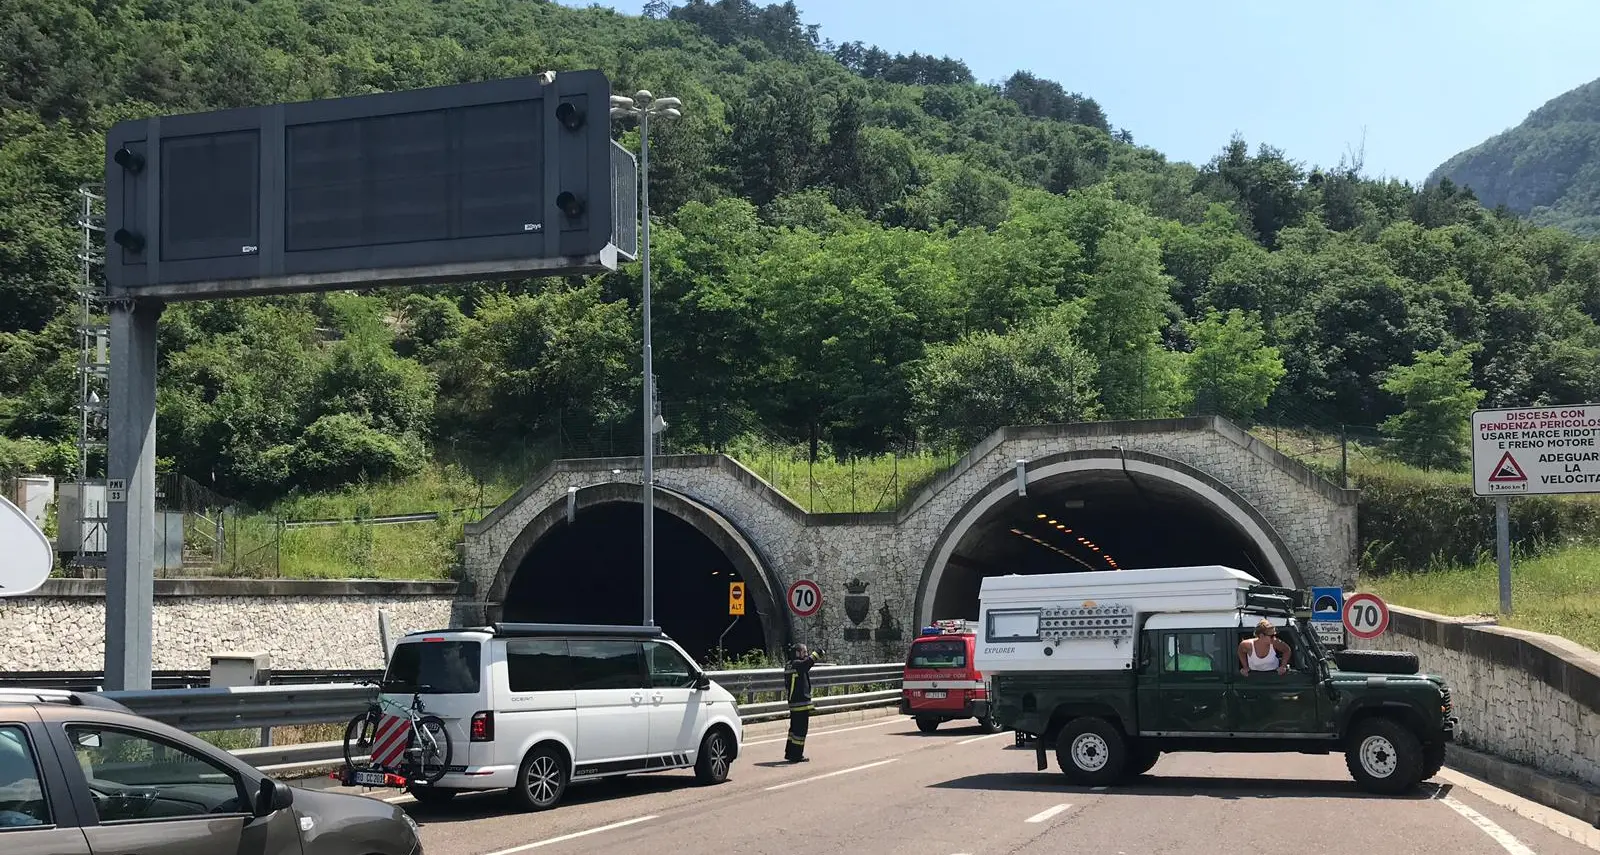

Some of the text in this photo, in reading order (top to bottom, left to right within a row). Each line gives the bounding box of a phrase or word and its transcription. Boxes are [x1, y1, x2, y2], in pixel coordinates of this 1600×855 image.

[1507, 410, 1585, 420] DISCESA CON
[1480, 421, 1536, 431] PENDENZA
[1482, 432, 1518, 440] USARE
[1522, 430, 1560, 438] MARCE
[1509, 440, 1544, 448] FRENO
[1548, 439, 1594, 447] MOTORE
[1565, 464, 1581, 472] LA
[796, 590, 814, 607] 70
[1353, 605, 1378, 626] 70
[984, 646, 1015, 654] EXPLORER
